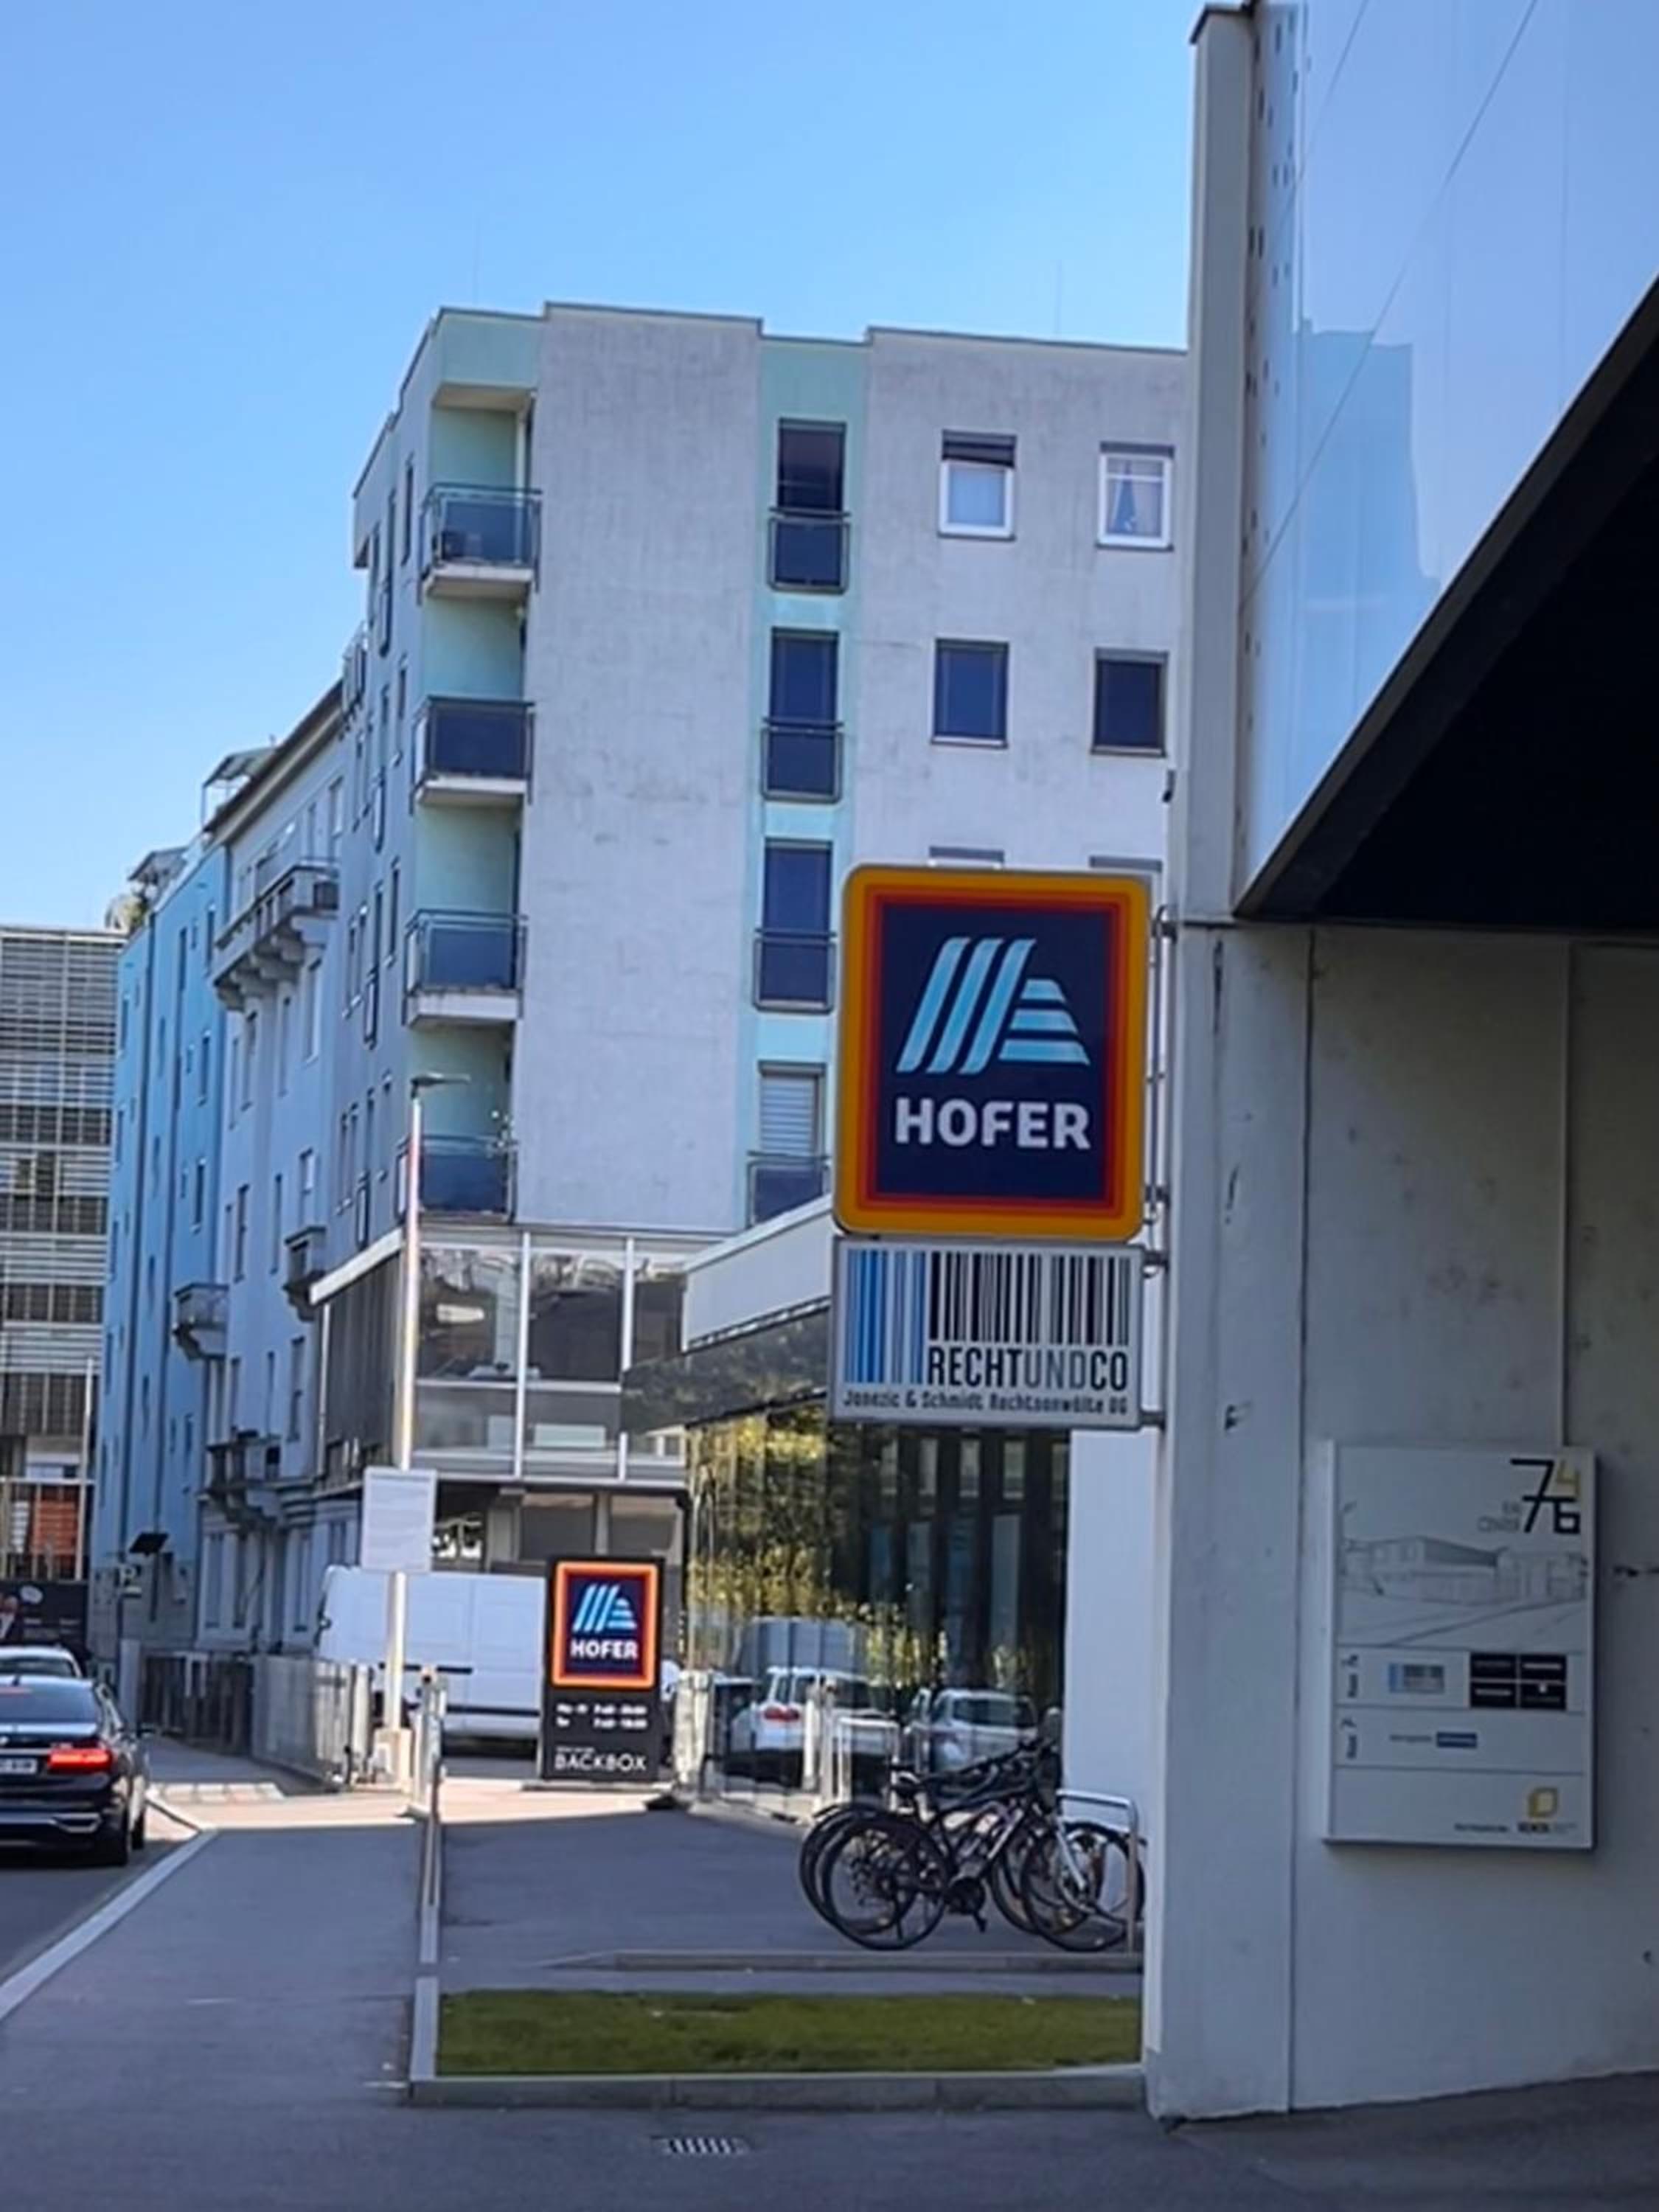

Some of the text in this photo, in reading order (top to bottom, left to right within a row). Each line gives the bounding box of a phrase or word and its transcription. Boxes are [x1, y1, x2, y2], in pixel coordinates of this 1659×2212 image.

[896, 1097, 1091, 1150] HOFER
[928, 1346, 1128, 1391] RECHTUNDCO
[571, 1639, 639, 1659] HOFER
